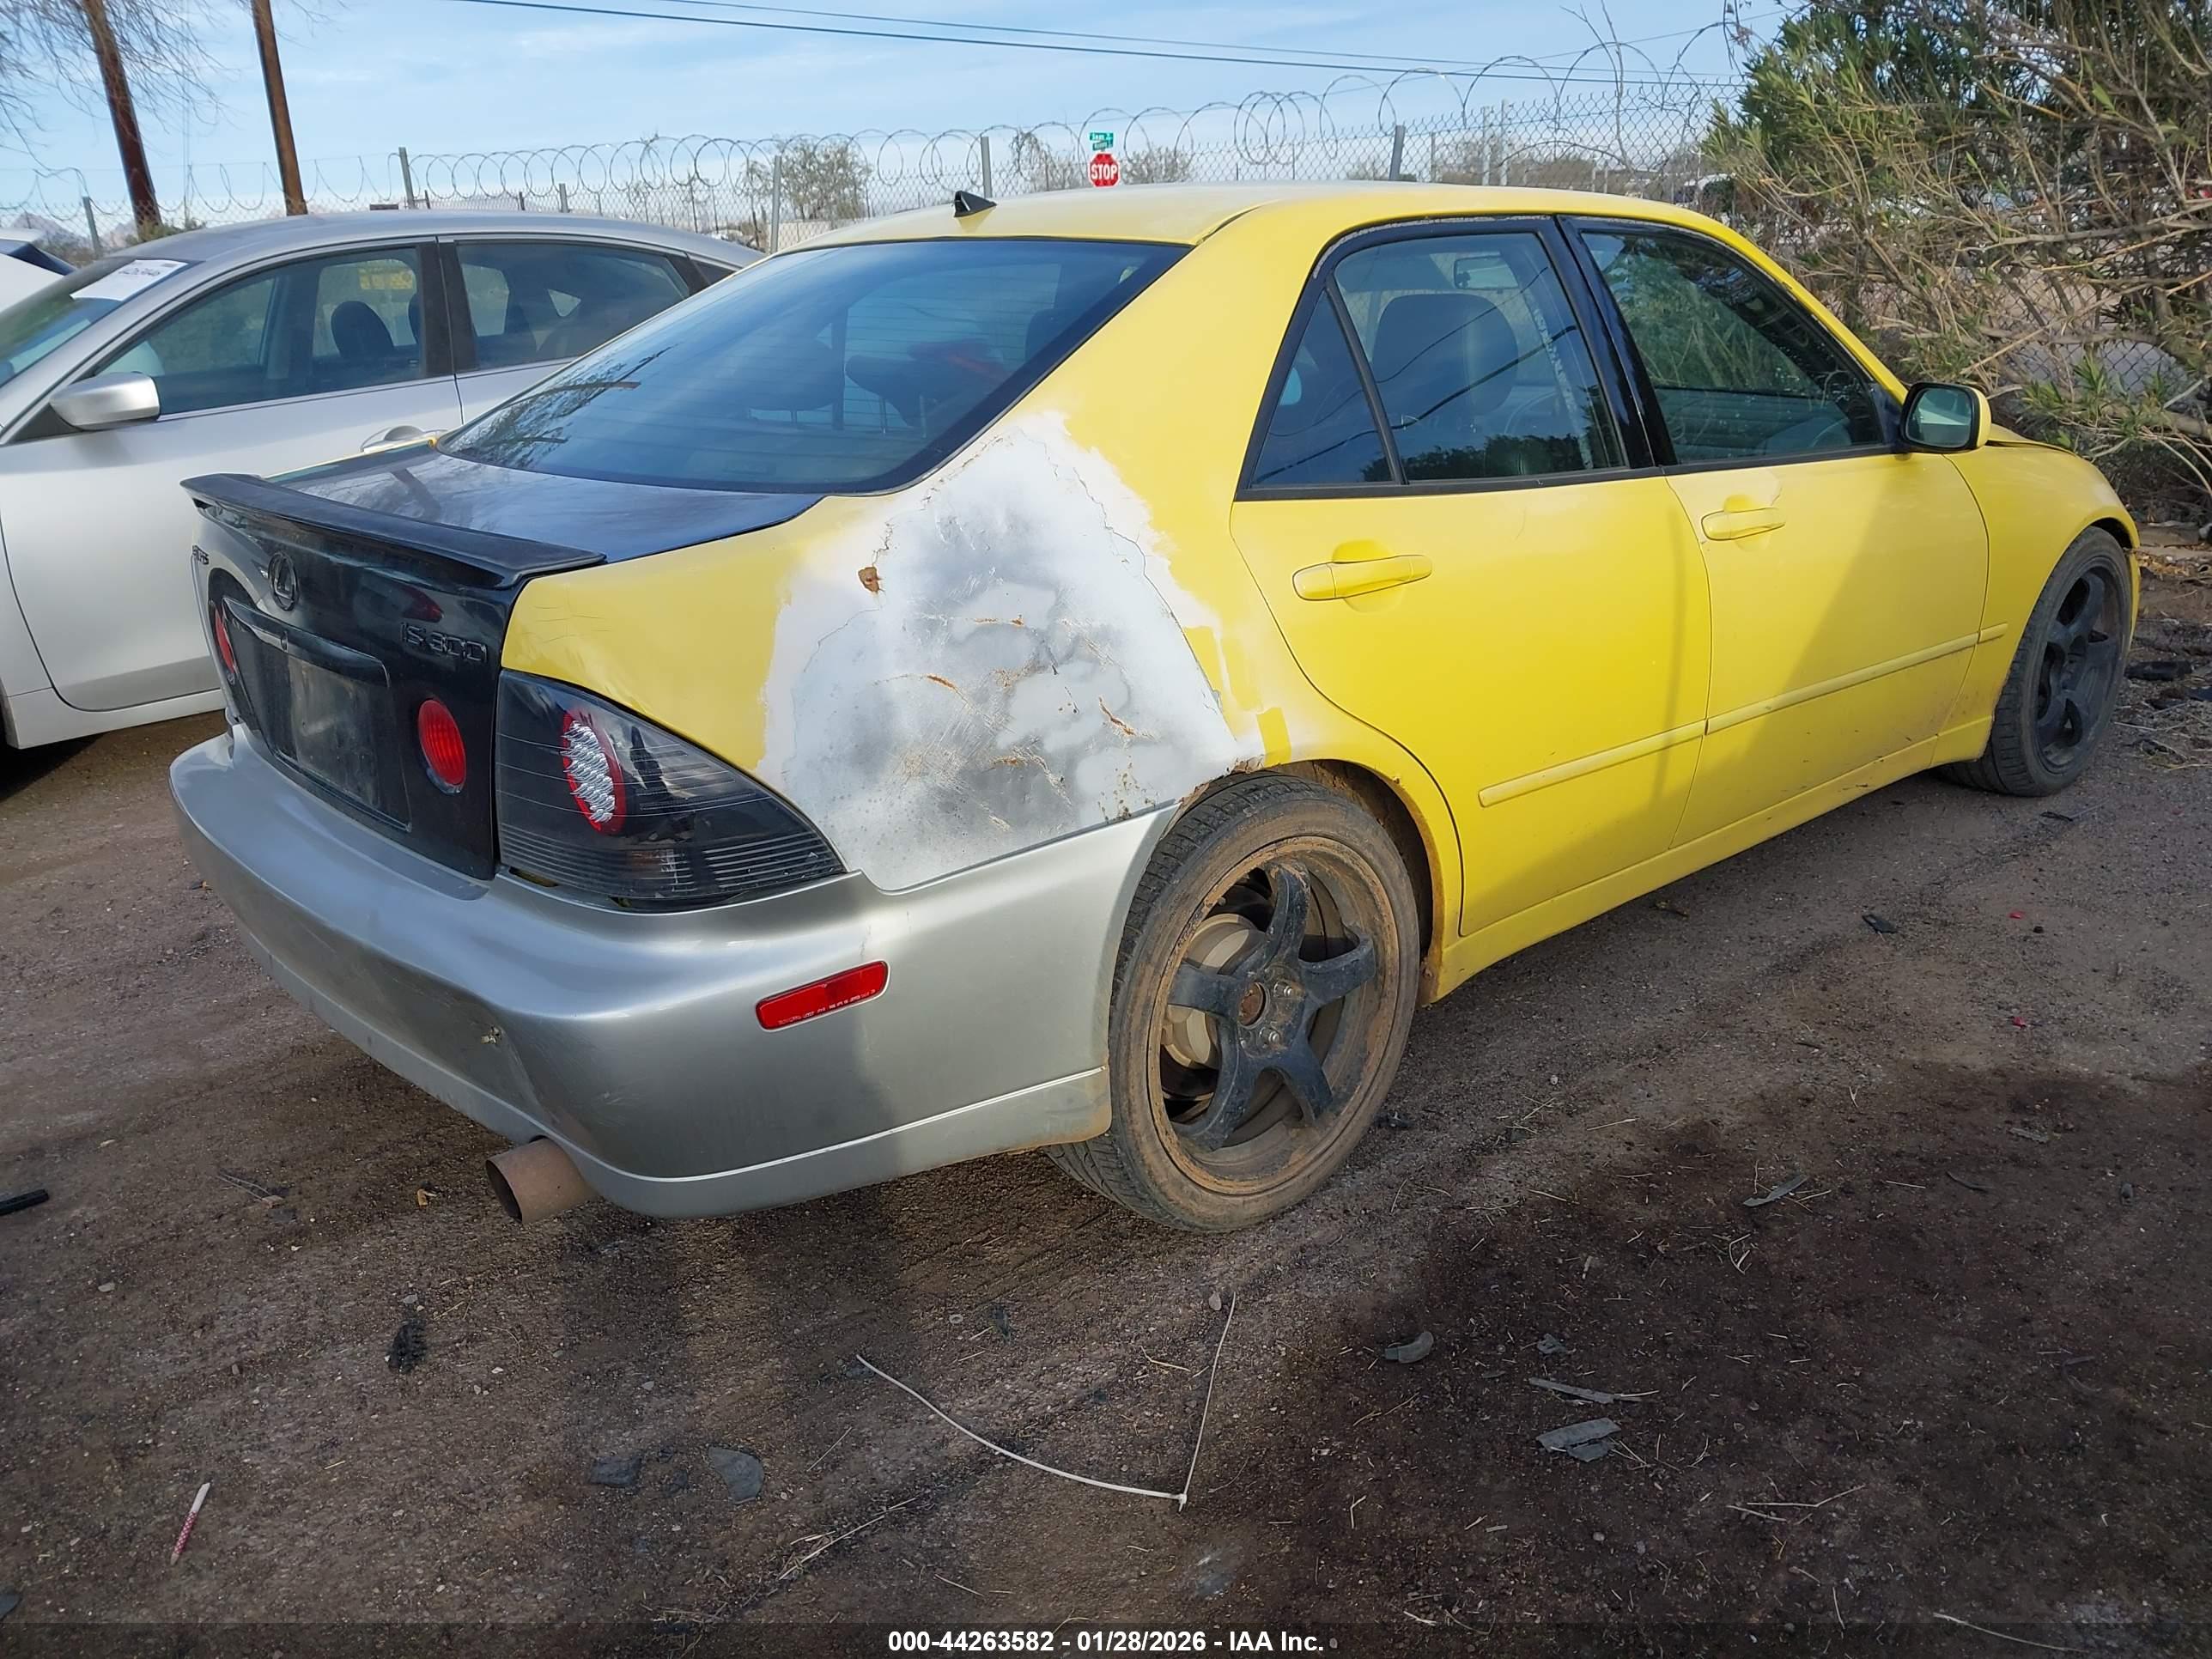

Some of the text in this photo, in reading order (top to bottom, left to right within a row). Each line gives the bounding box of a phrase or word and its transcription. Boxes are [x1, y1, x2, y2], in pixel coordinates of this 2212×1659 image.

[1091, 163, 1117, 179] STOP
[401, 622, 488, 663] IS 300
